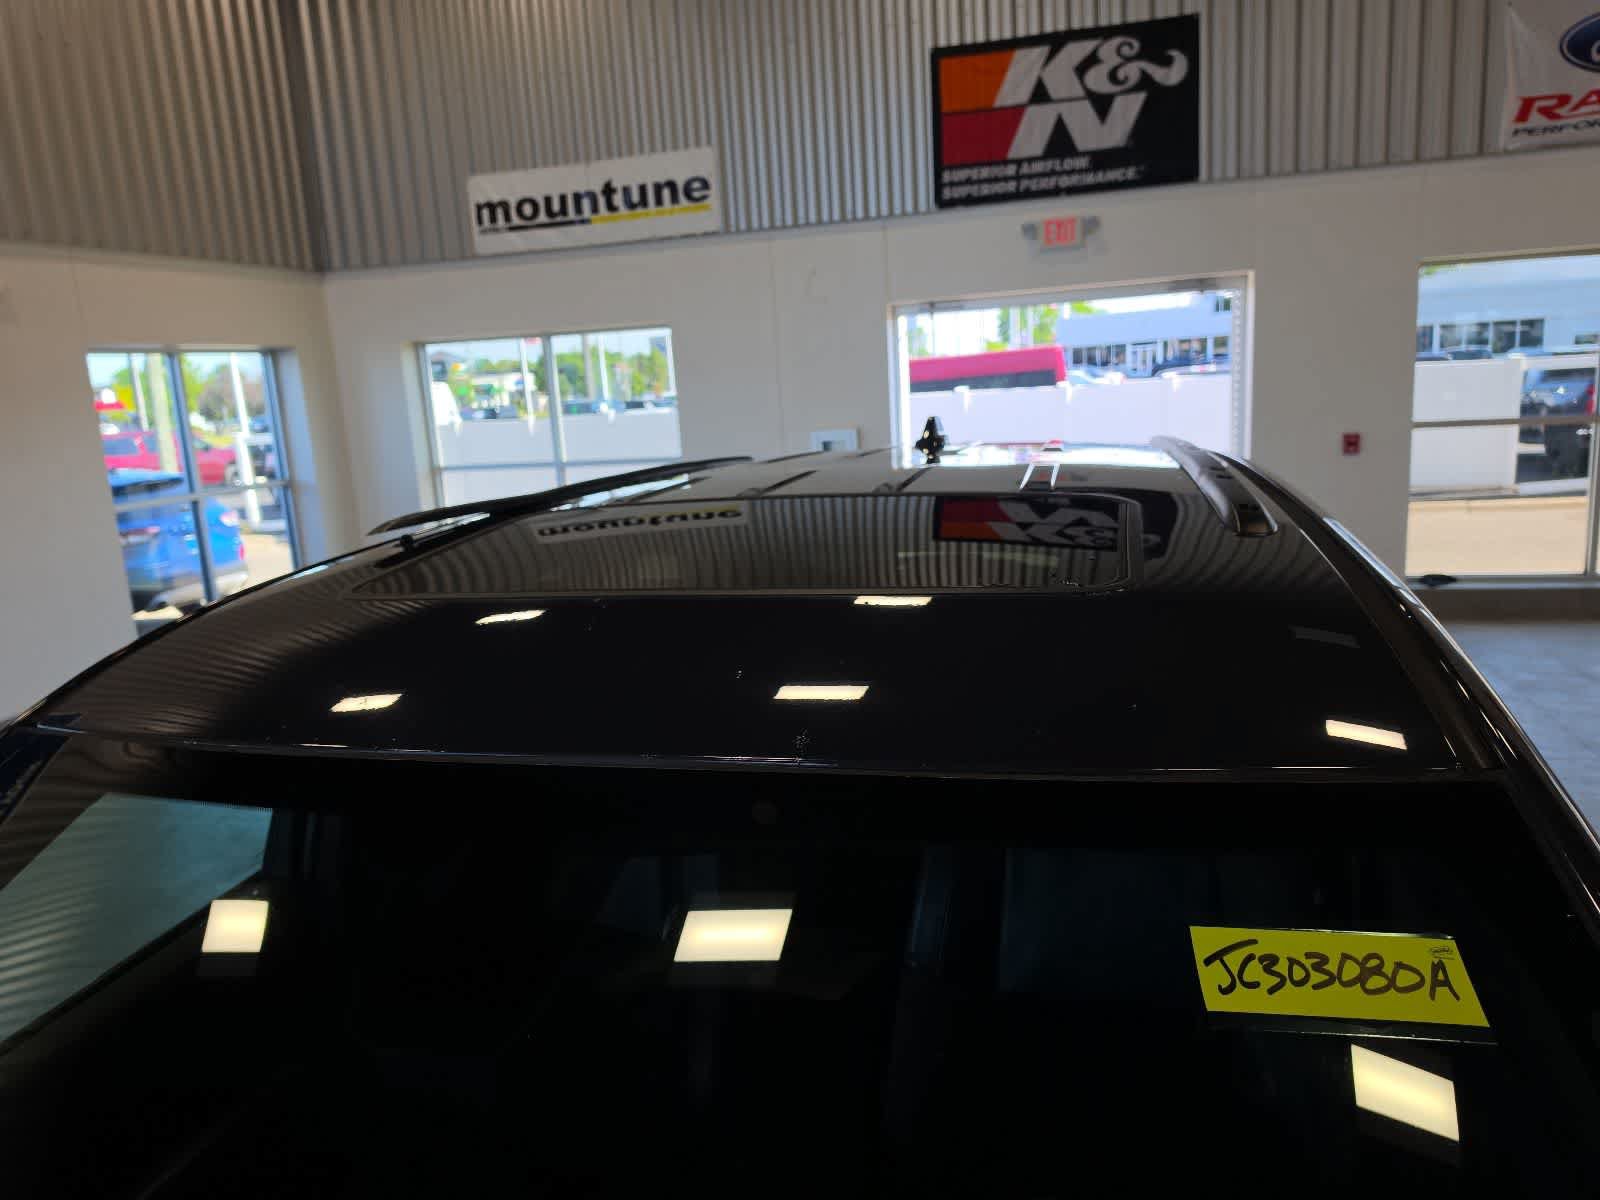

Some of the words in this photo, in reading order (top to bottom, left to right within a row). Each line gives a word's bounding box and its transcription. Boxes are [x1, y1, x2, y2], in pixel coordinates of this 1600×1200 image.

[941, 163, 1017, 184] SUPERIOR
[475, 174, 711, 226] mountune
[941, 179, 1017, 200] SUPERIOR
[1043, 216, 1077, 246] EXIT
[1202, 939, 1461, 1002] JC303080A
